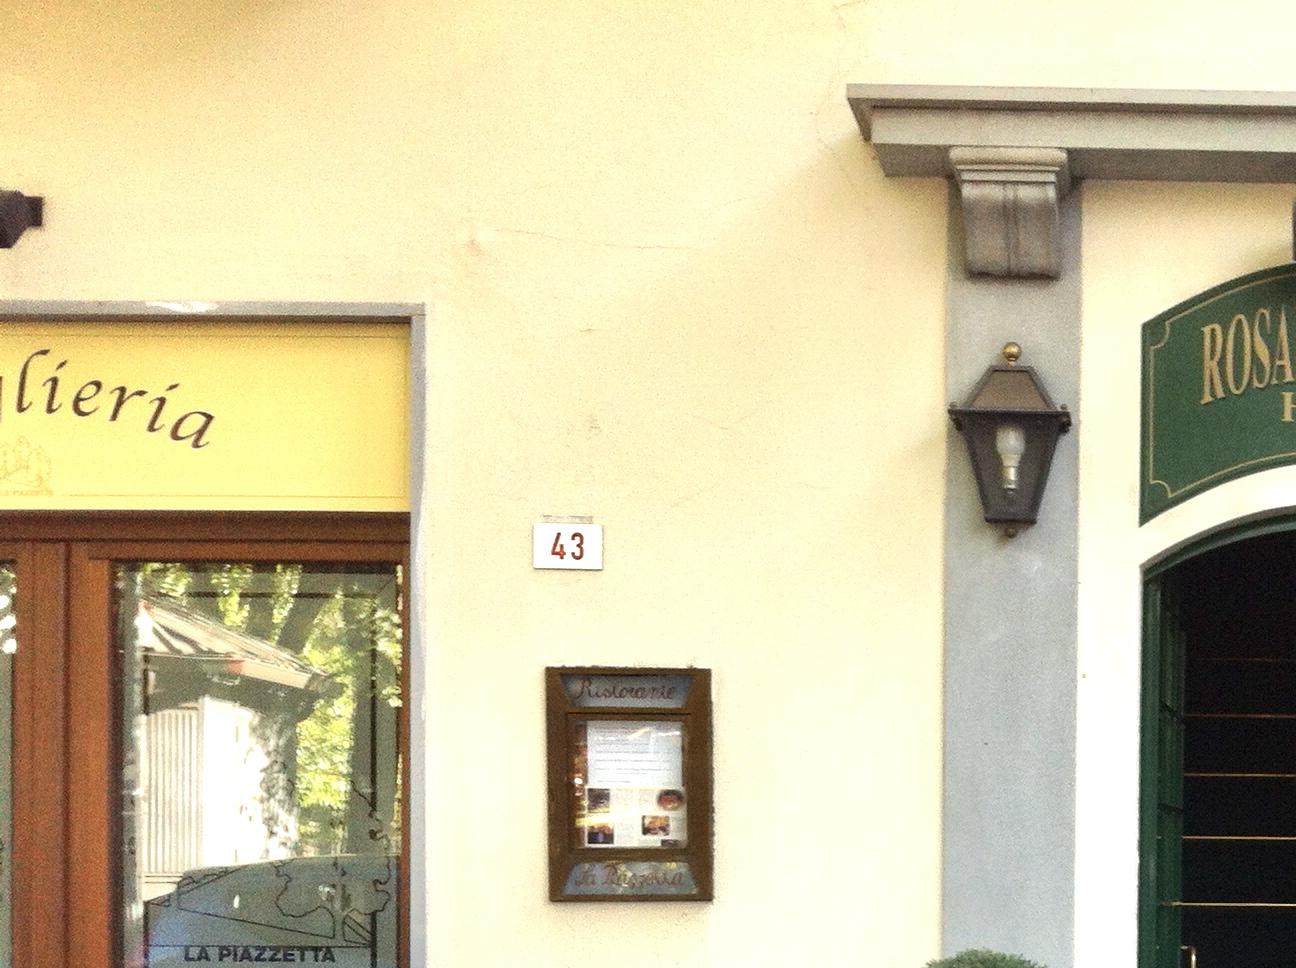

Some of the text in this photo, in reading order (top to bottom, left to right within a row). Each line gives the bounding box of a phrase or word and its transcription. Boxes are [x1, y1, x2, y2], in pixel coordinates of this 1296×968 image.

[0, 349, 215, 449] lieria
[551, 532, 585, 561] 43
[184, 945, 336, 963] LA PIAZZETTA
